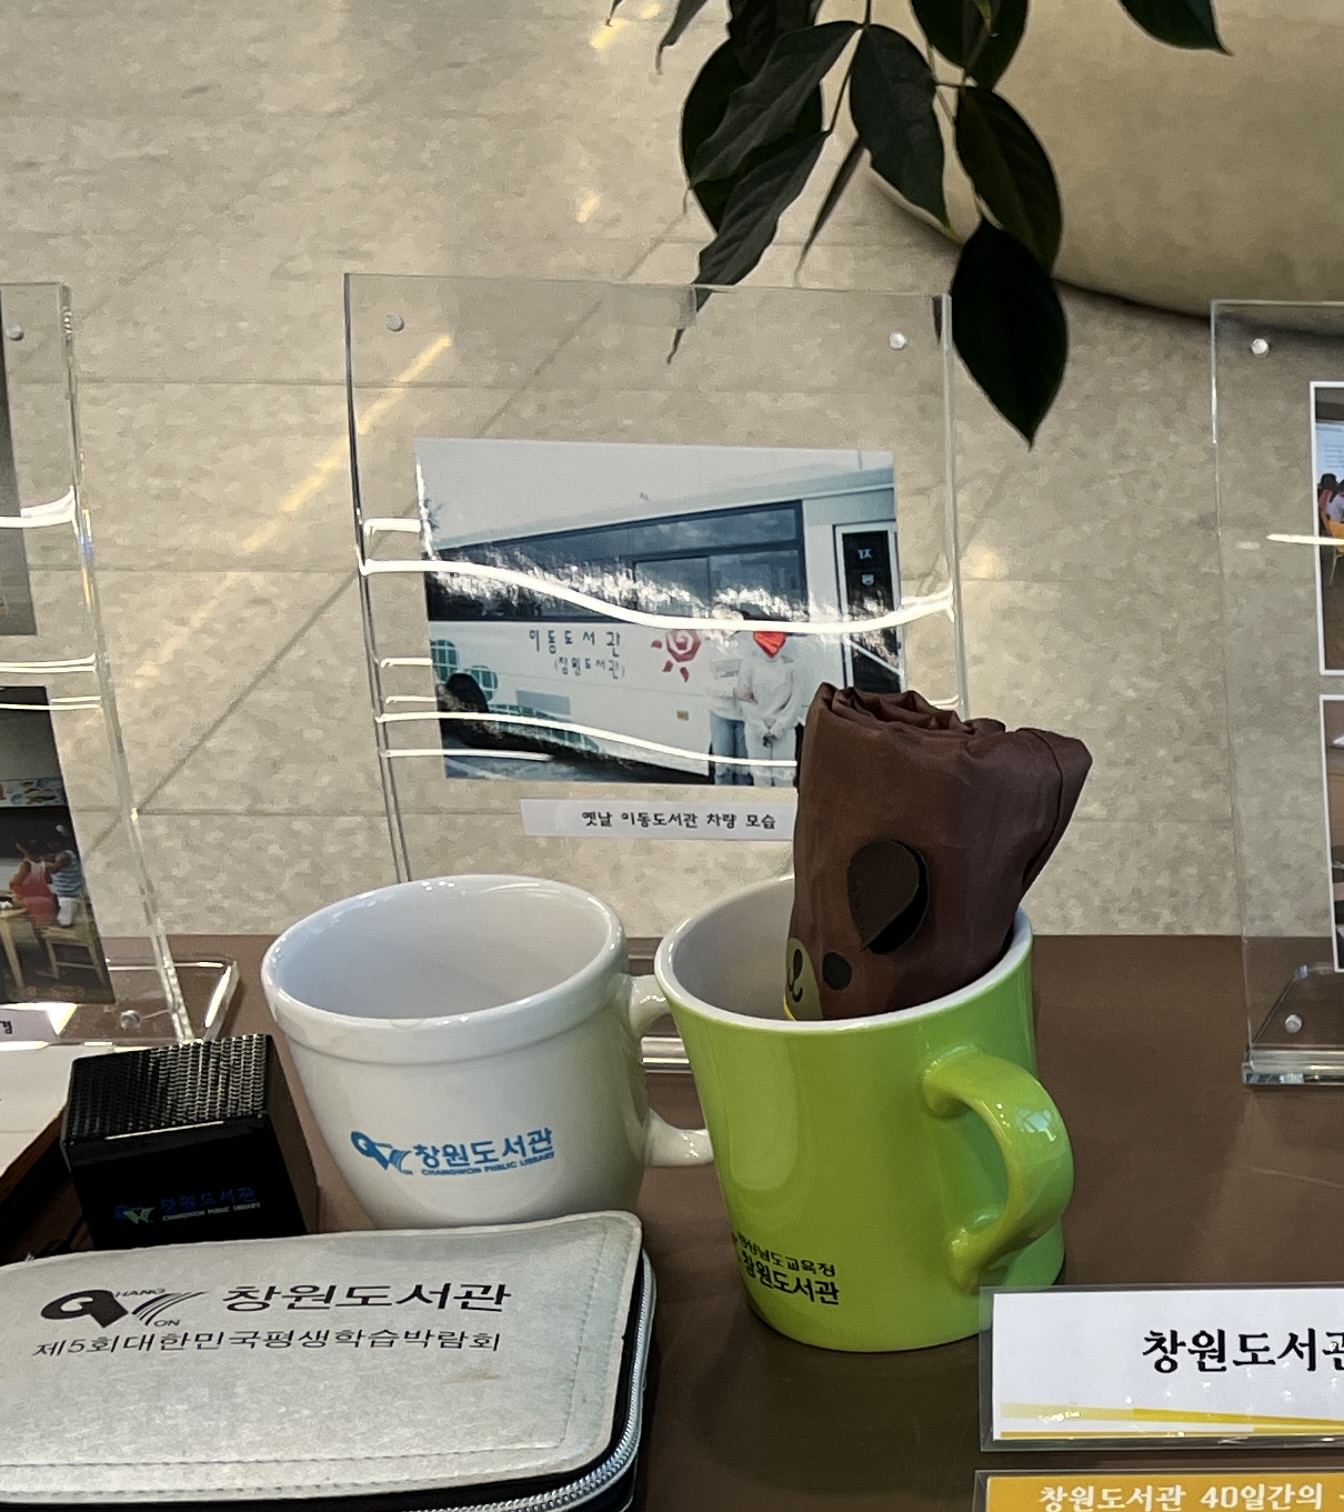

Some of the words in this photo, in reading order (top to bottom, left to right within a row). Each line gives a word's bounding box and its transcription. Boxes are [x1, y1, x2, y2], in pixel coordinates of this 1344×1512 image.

[582, 811, 612, 827] 옛날
[621, 812, 697, 828] 이동도서관
[707, 813, 736, 829] 차량
[746, 814, 775, 829] 모습
[414, 1127, 553, 1168] 창원도서관
[222, 1280, 511, 1314] 창원도서관
[34, 1326, 501, 1360] 제5회대한민국평생학습박람회
[1039, 1485, 1186, 1512] 창원도서관
[1200, 1483, 1322, 1511] 40일간의
